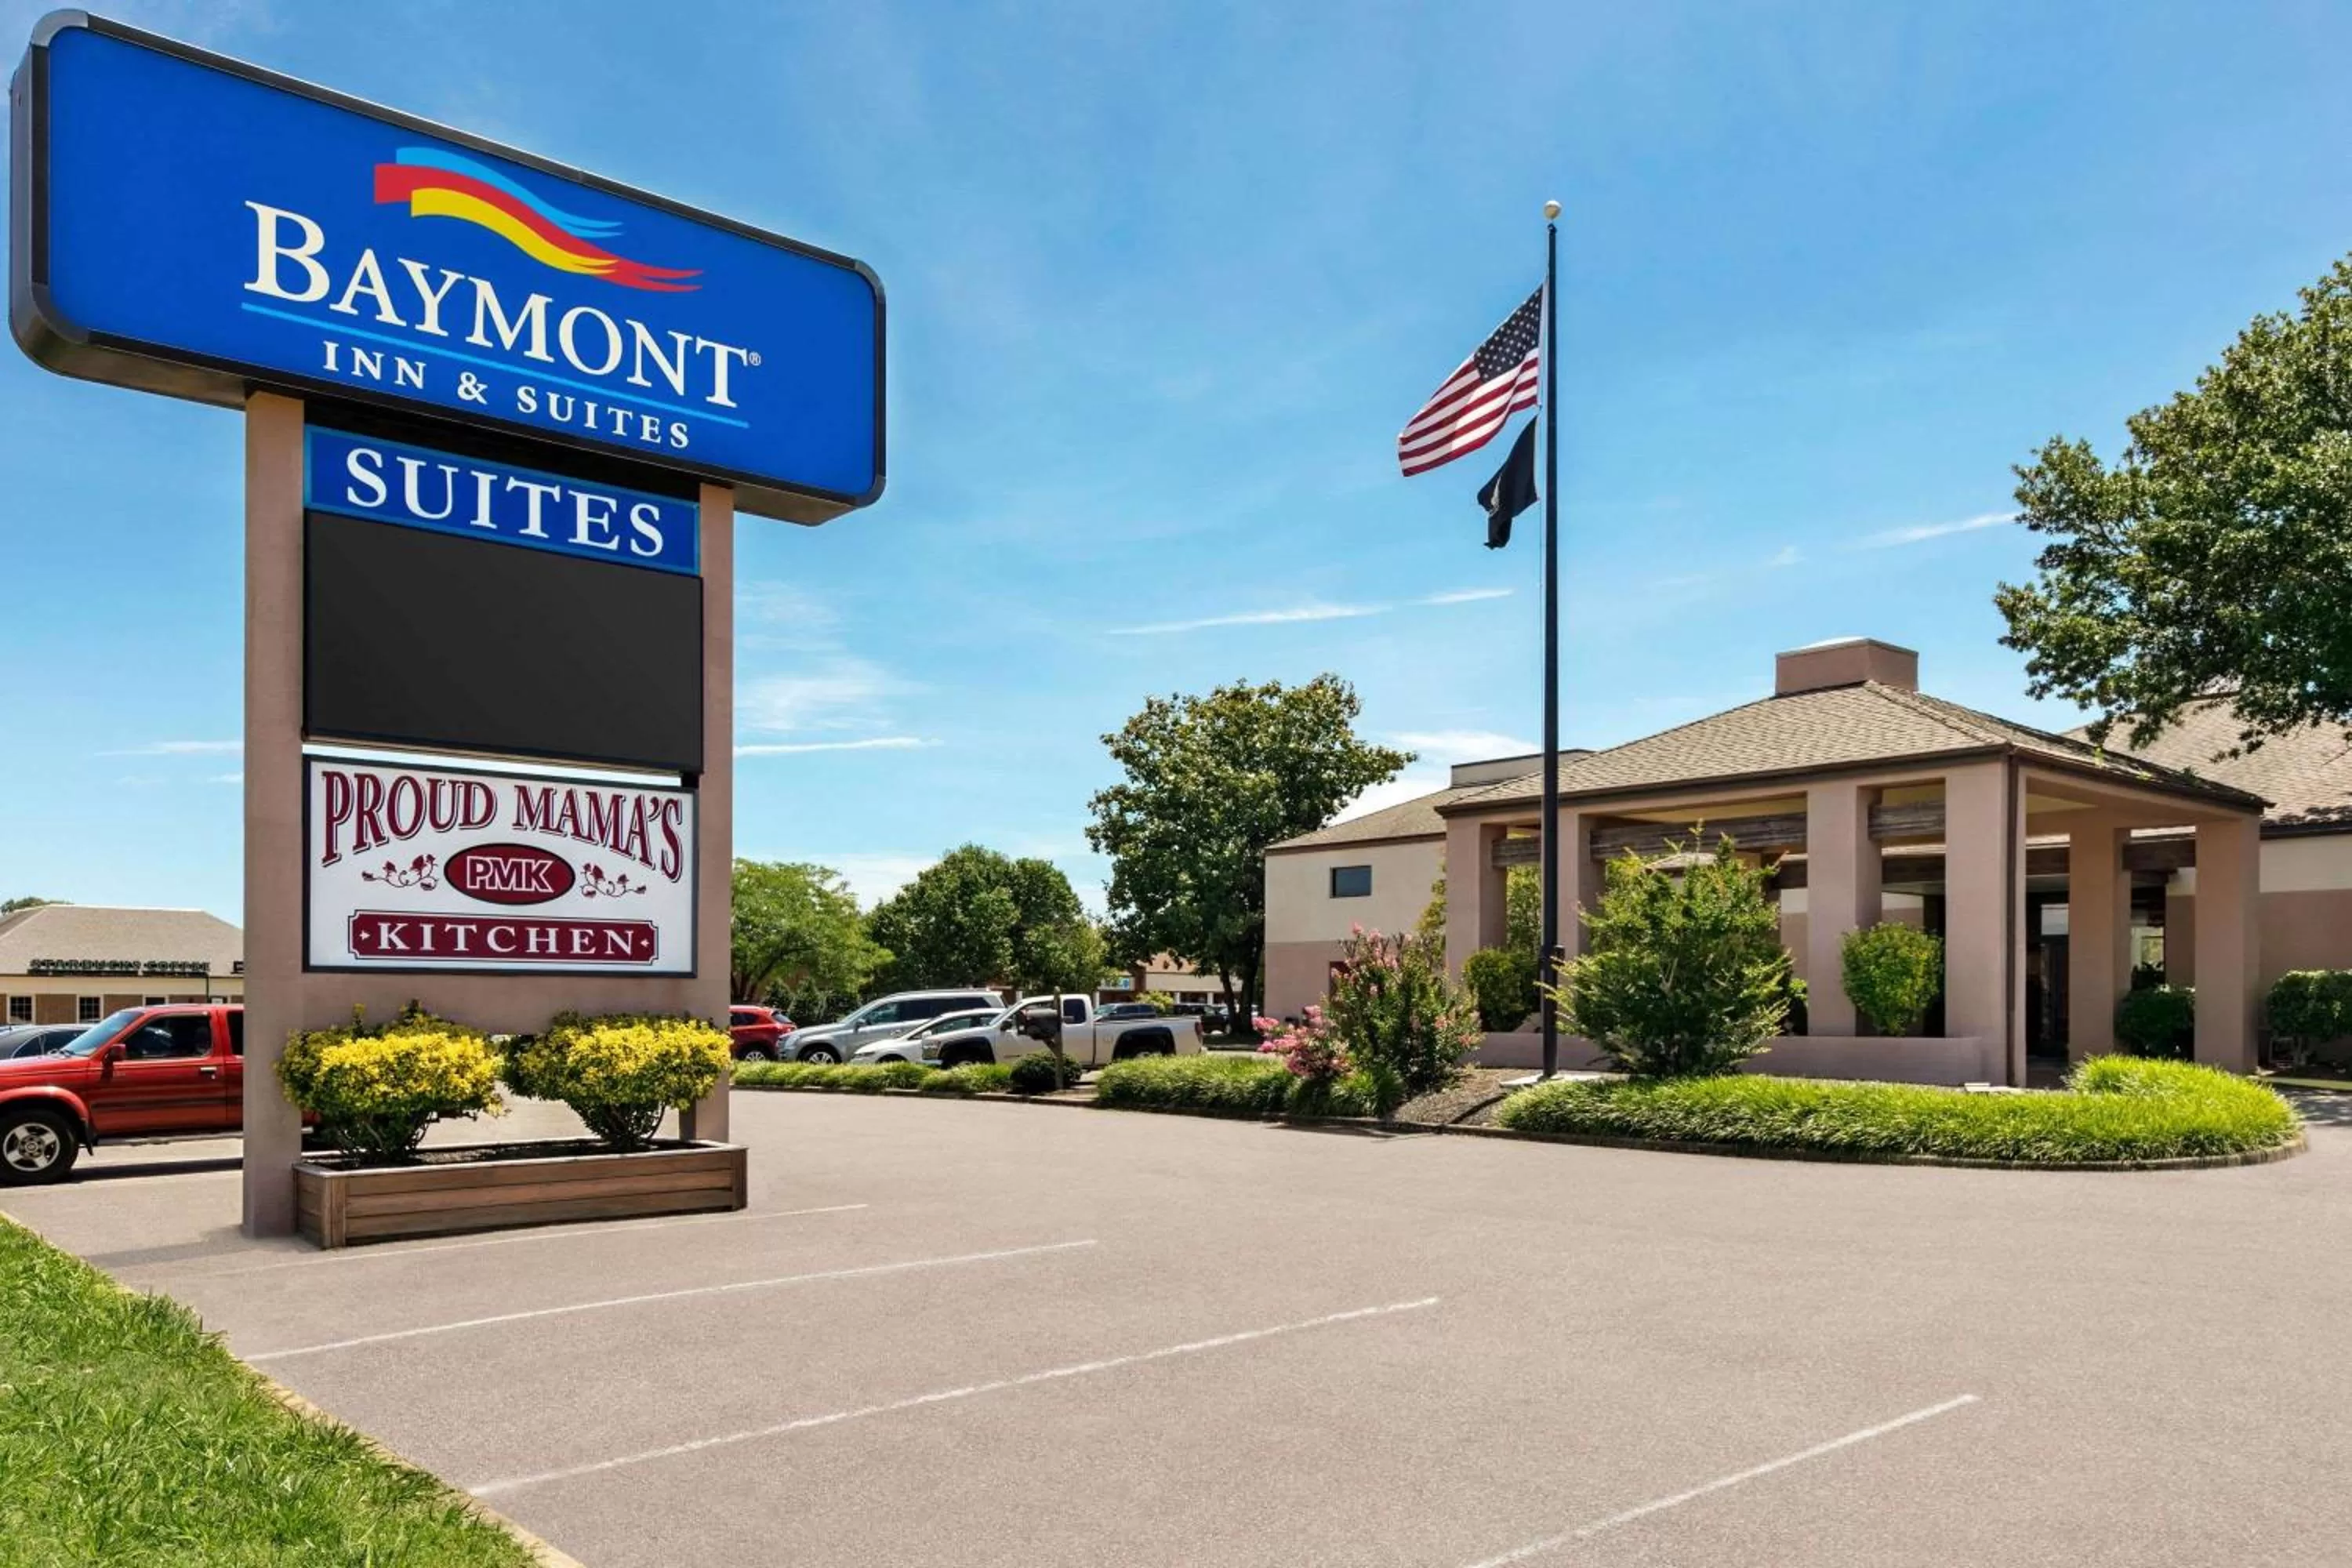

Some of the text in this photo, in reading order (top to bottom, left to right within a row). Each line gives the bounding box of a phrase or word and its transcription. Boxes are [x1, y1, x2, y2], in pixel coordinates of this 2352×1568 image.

[323, 340, 689, 448] INN & SUITES
[347, 448, 664, 557] SUITES
[321, 770, 684, 884] PROUD MAMA'S
[466, 855, 554, 894] PMK
[378, 922, 633, 955] KITCHEN
